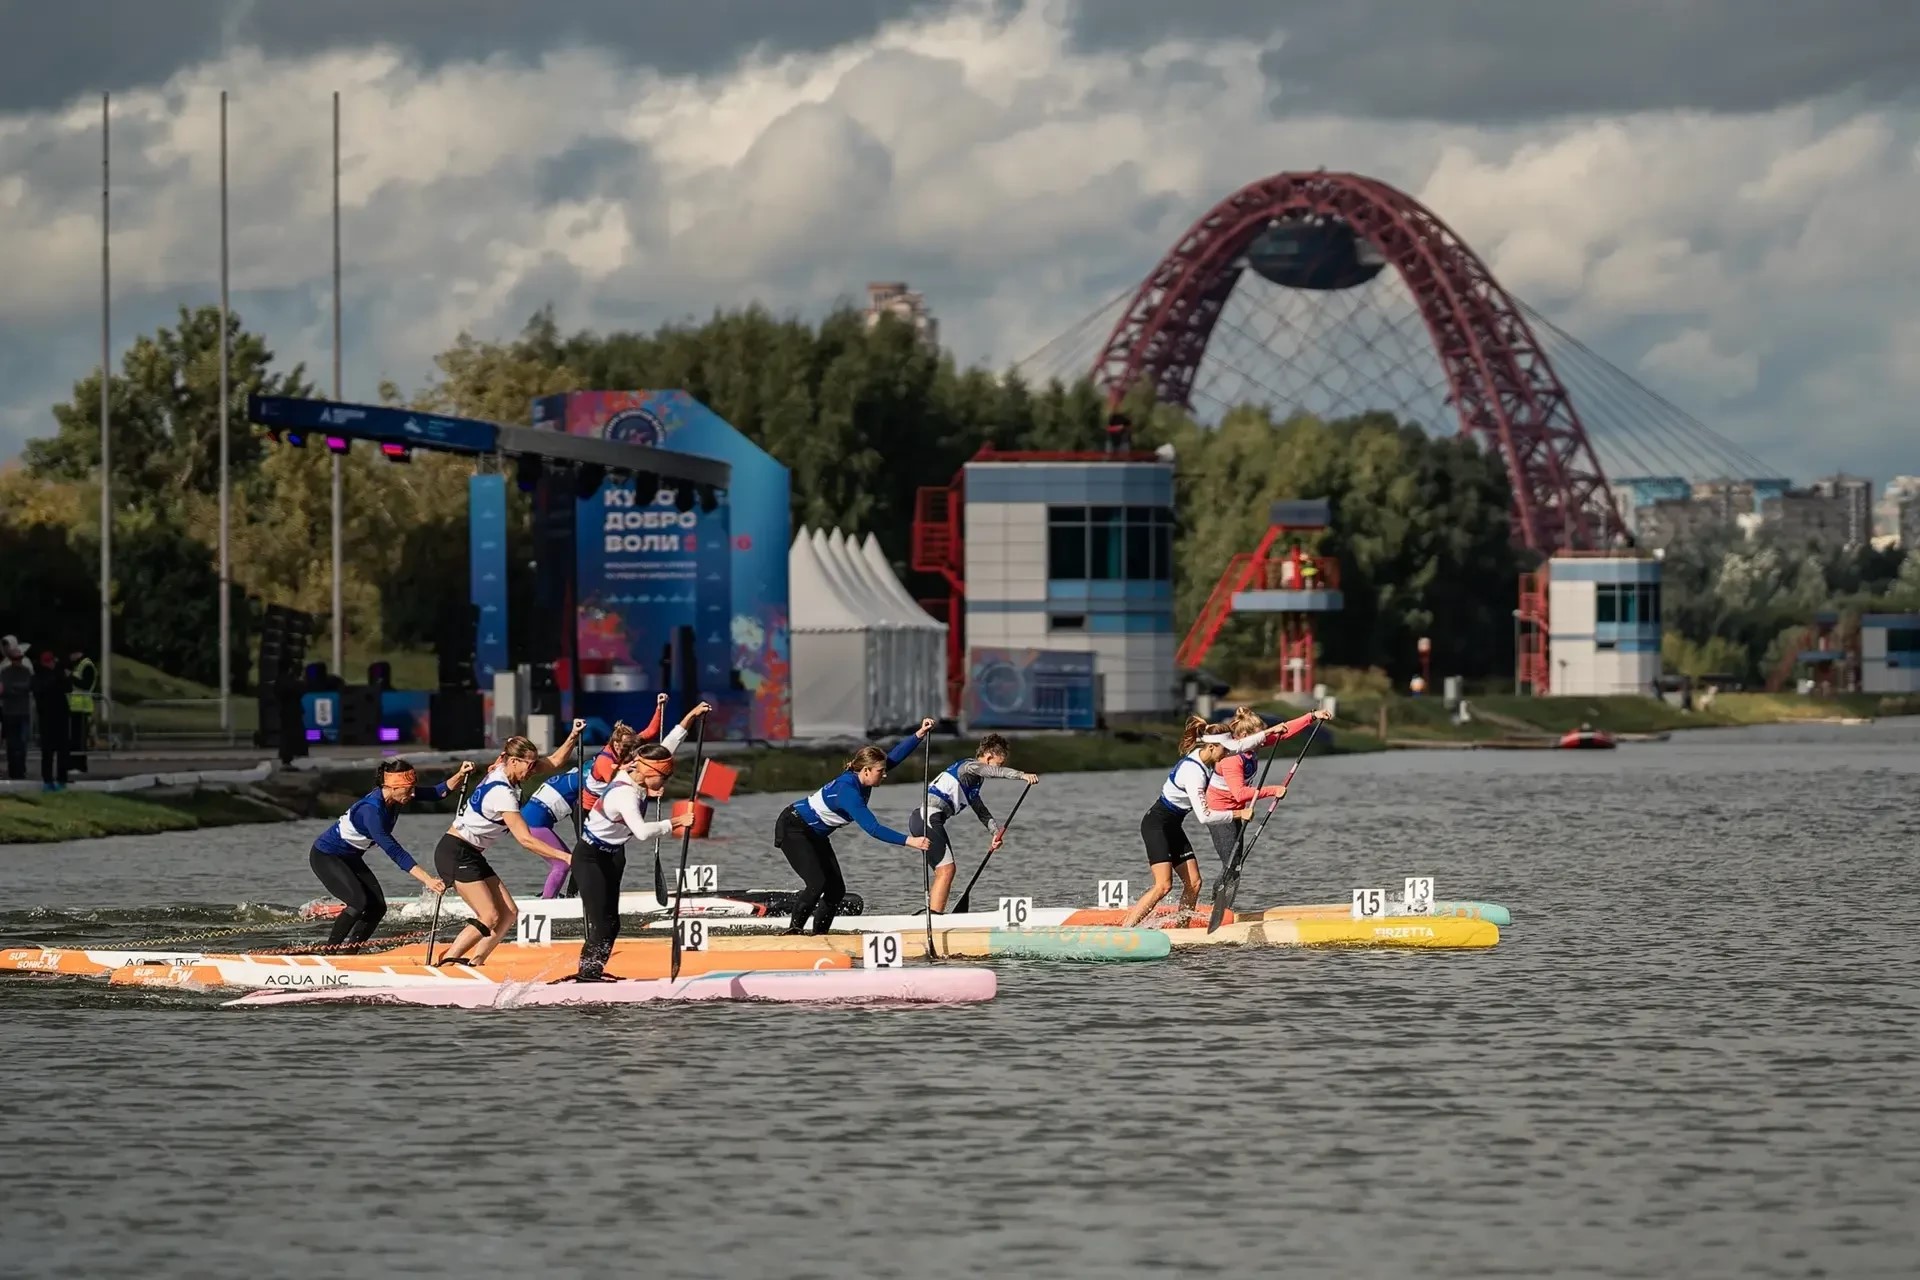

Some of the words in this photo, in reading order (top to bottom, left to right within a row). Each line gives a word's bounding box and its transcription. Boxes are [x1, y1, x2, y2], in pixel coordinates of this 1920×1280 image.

[604, 489, 678, 506] КУО
[604, 512, 697, 530] ДОБРО
[604, 535, 680, 552] ВОЛИ
[694, 867, 714, 888] 12
[1101, 881, 1124, 903] 14
[1408, 879, 1430, 900] 13
[1002, 898, 1027, 923] 16
[1356, 890, 1380, 915] 15
[521, 914, 546, 942] 17
[679, 920, 703, 946] 18
[869, 936, 897, 964] 19
[265, 975, 315, 985] AQUA
[321, 975, 348, 985] INC
